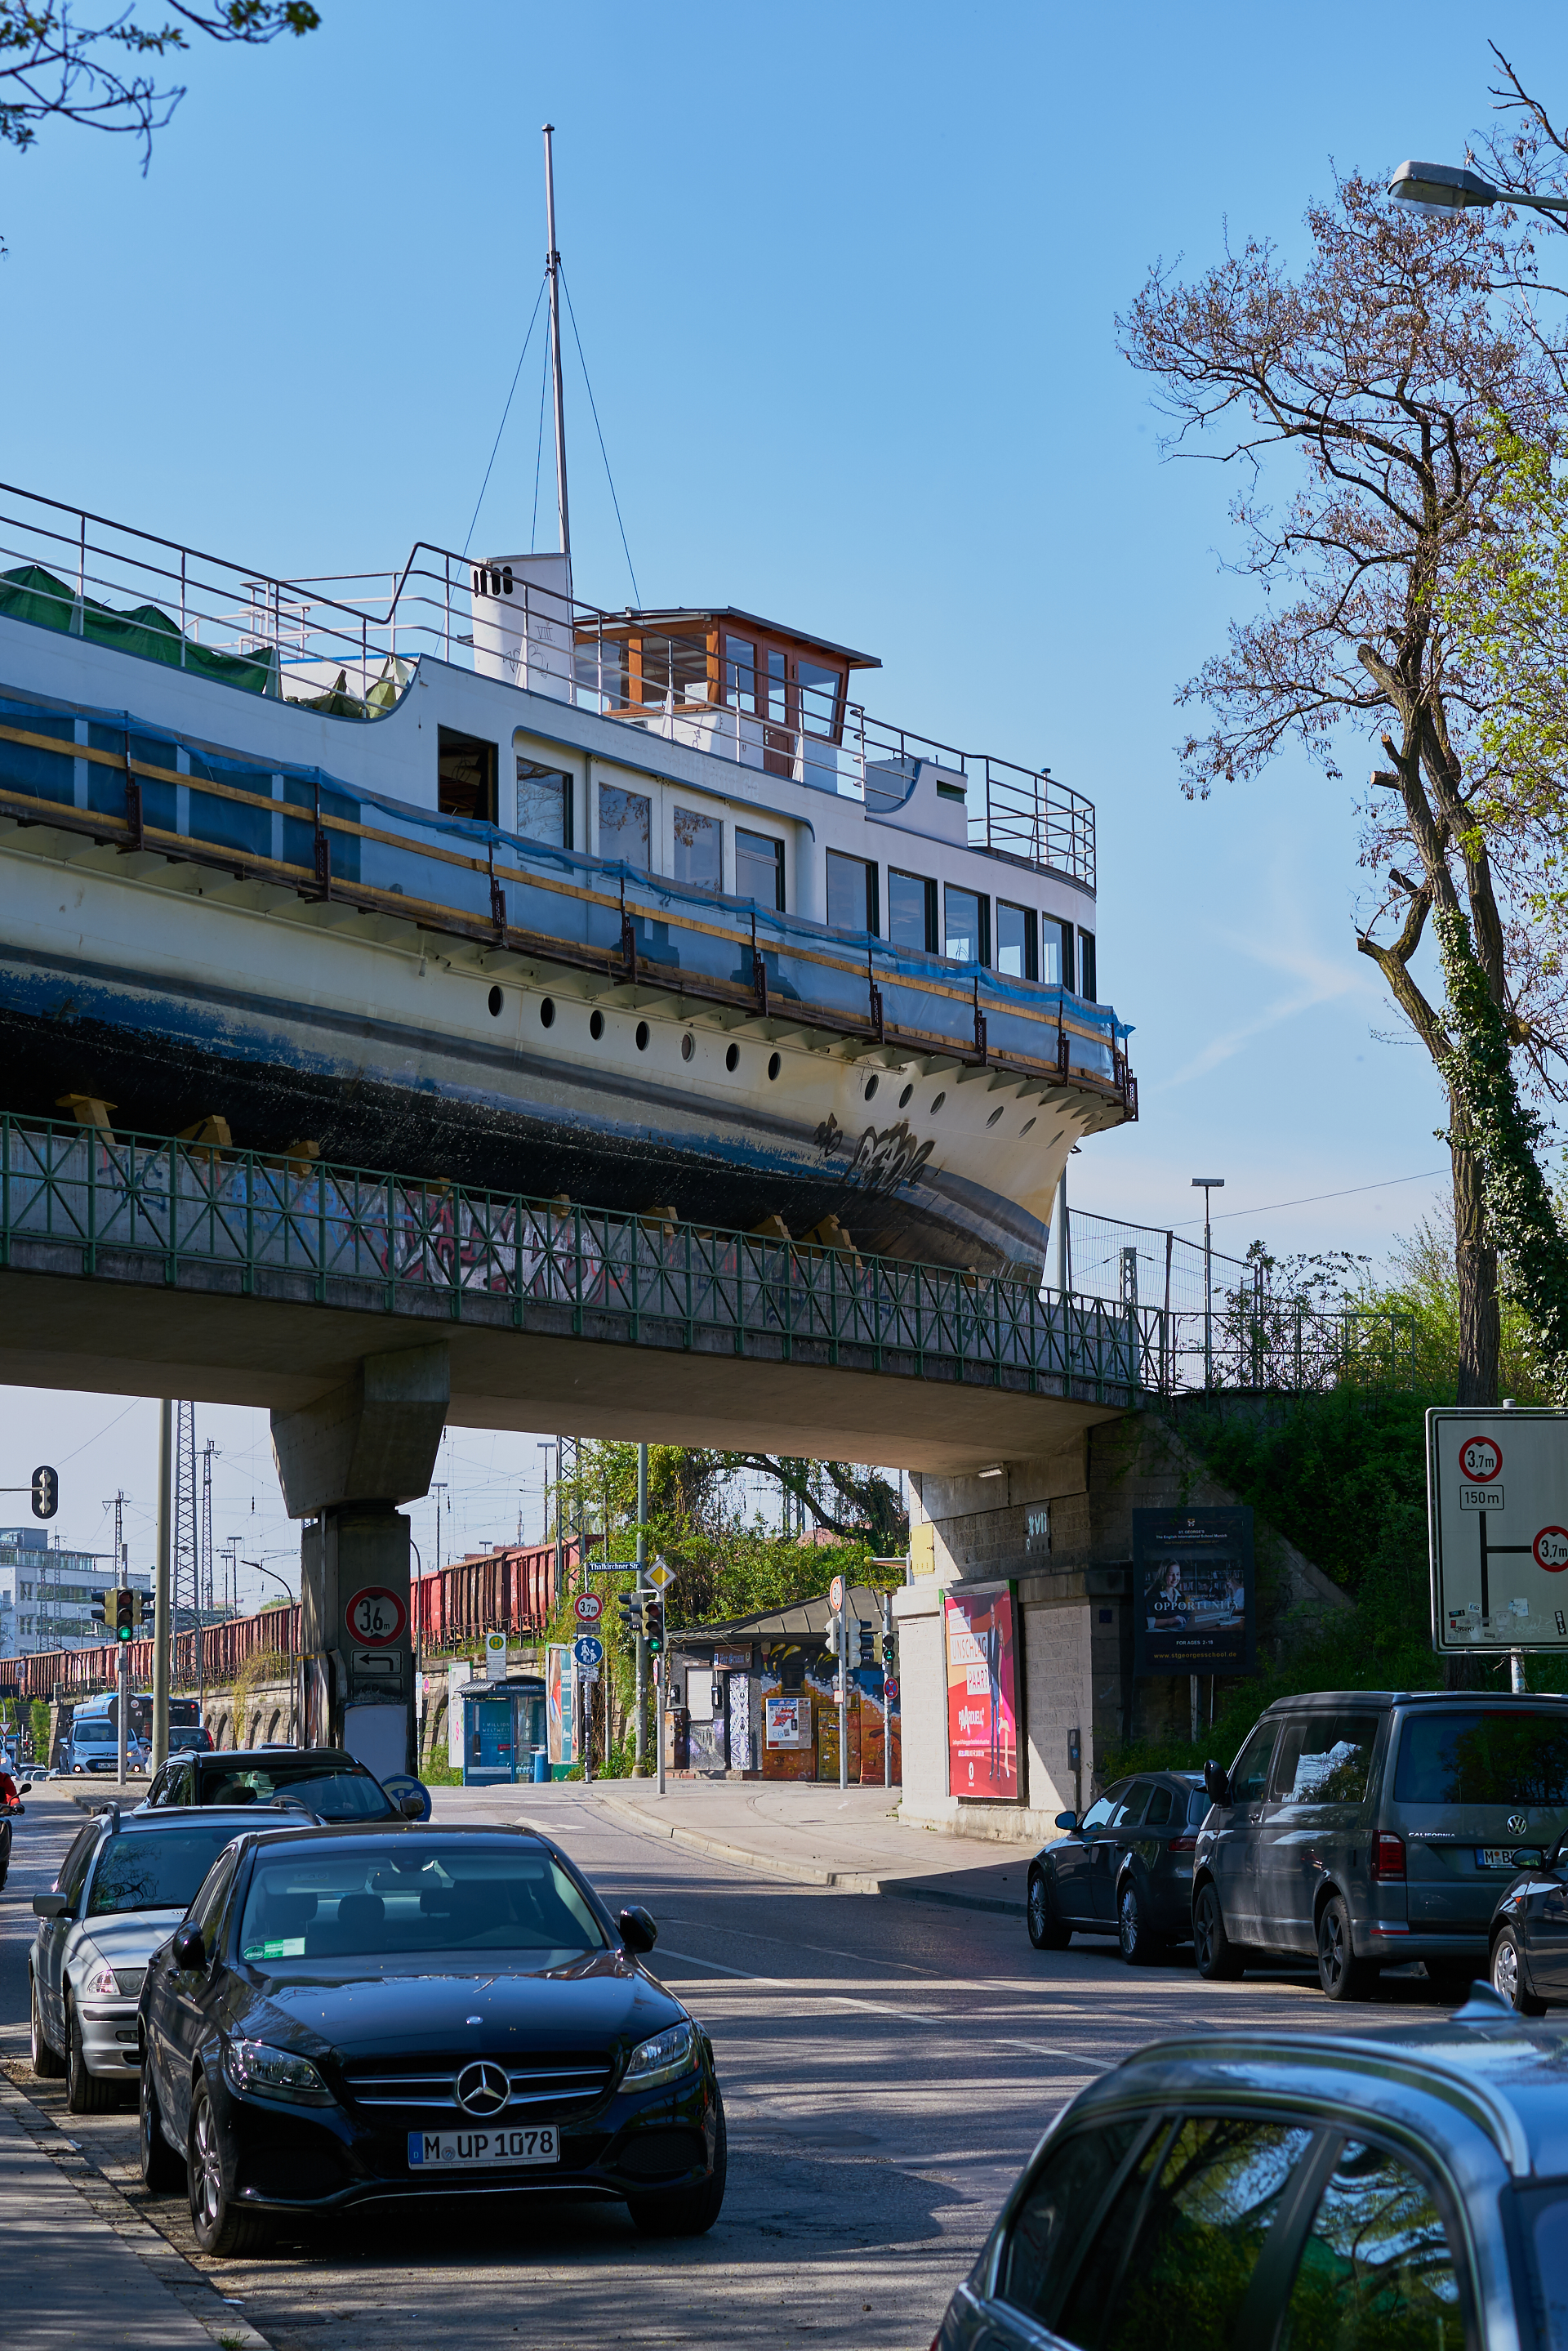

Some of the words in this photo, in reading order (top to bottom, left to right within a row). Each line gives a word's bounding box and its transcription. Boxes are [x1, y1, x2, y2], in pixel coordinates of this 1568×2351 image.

[1467, 1450, 1494, 1469] 3,7m
[1154, 1600, 1239, 1612] OPPORTUNITY
[952, 1637, 987, 1660] UNSCHLAG
[1154, 1651, 1237, 1659] www.stgeorgesschool.de
[969, 1668, 987, 1689] PAAR?
[1485, 1850, 1494, 1864] M
[425, 2135, 440, 2160] M
[457, 2135, 489, 2158] UP
[494, 2130, 554, 2157] 1078
